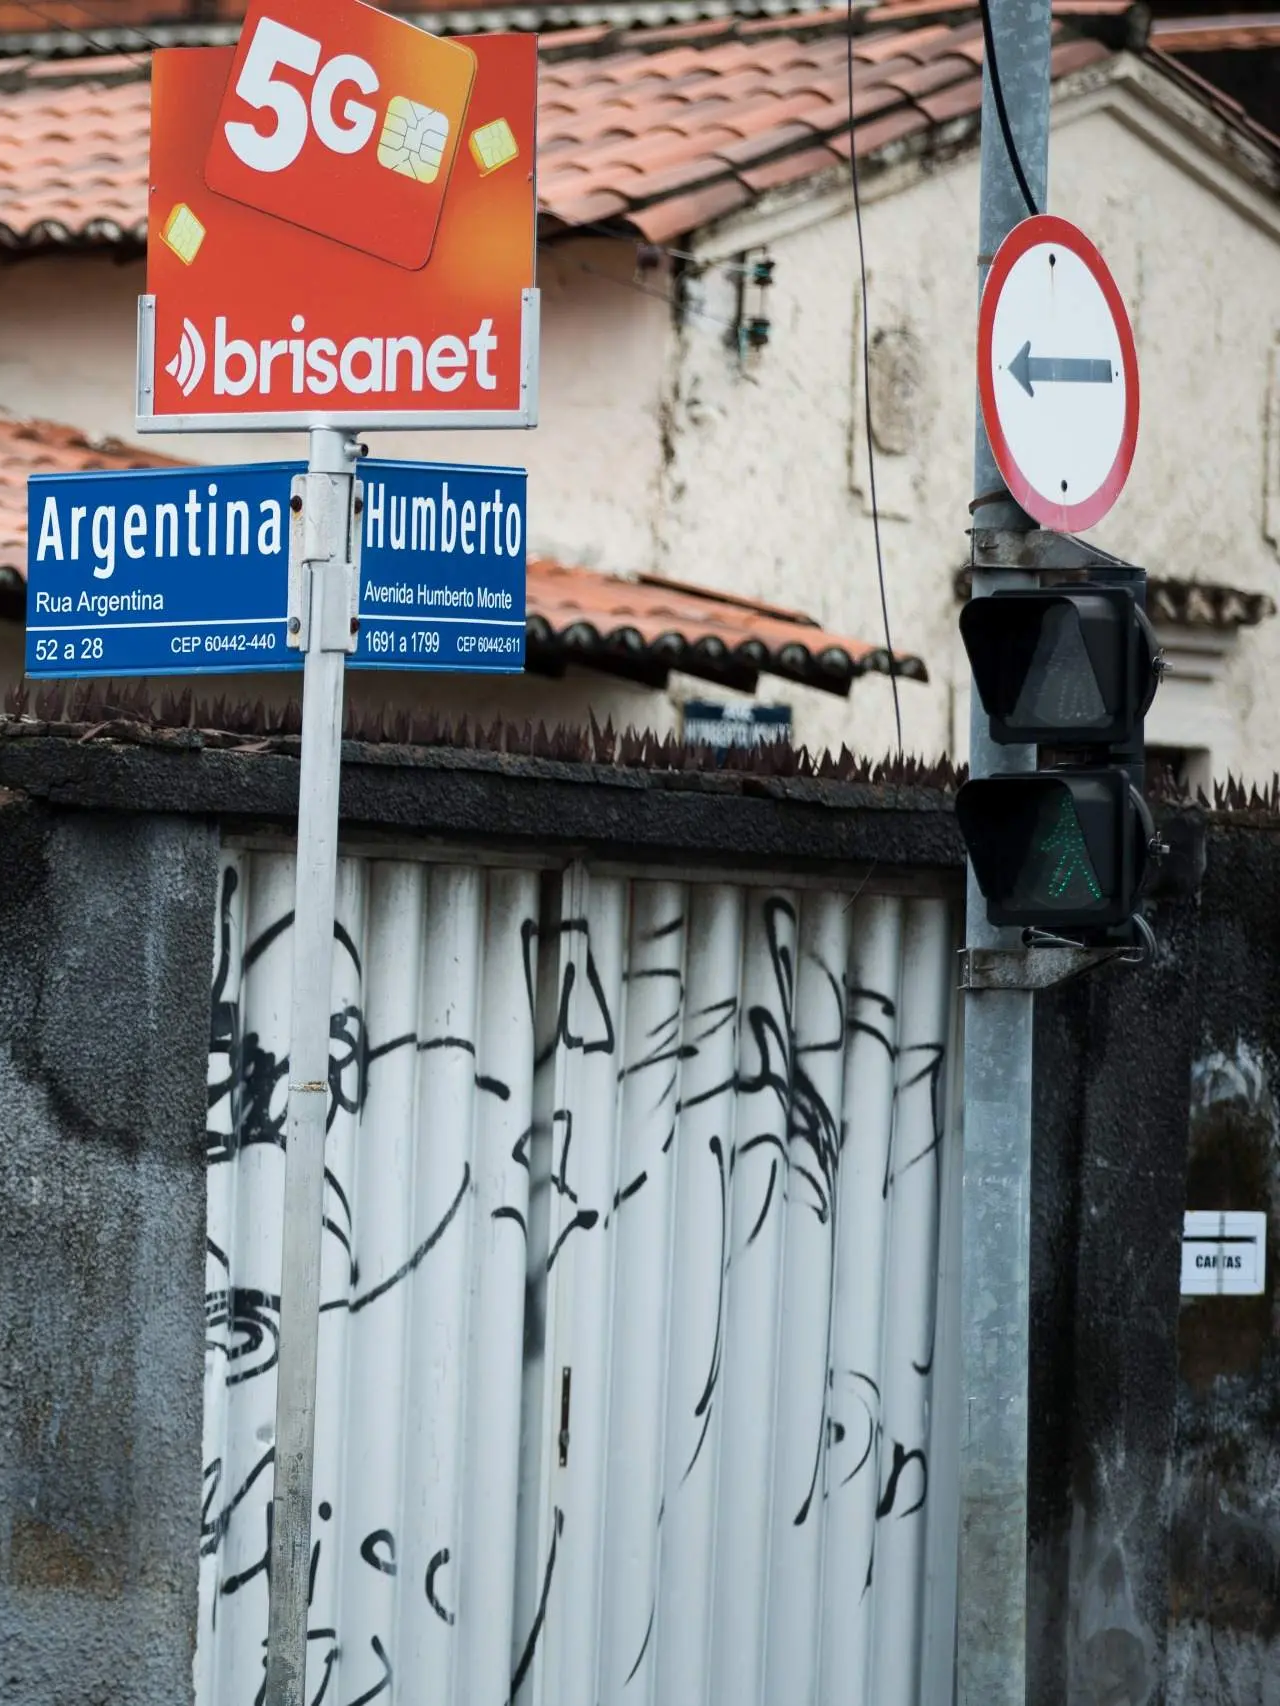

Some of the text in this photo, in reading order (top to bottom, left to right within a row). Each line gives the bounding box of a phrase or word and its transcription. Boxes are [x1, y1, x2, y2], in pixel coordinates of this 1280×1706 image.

[224, 16, 380, 172] 5G
[213, 314, 498, 396] brisanet
[36, 483, 282, 579] Argentina
[366, 481, 522, 557] Humberto
[35, 589, 164, 617] Rua Argentina
[364, 580, 512, 609] Avenida Humberto Monte
[35, 638, 104, 661] 52 a 28
[171, 633, 276, 653] CEP 60442-440
[365, 631, 440, 653] 1691 a 1799
[456, 636, 521, 653] CEP 60442-611
